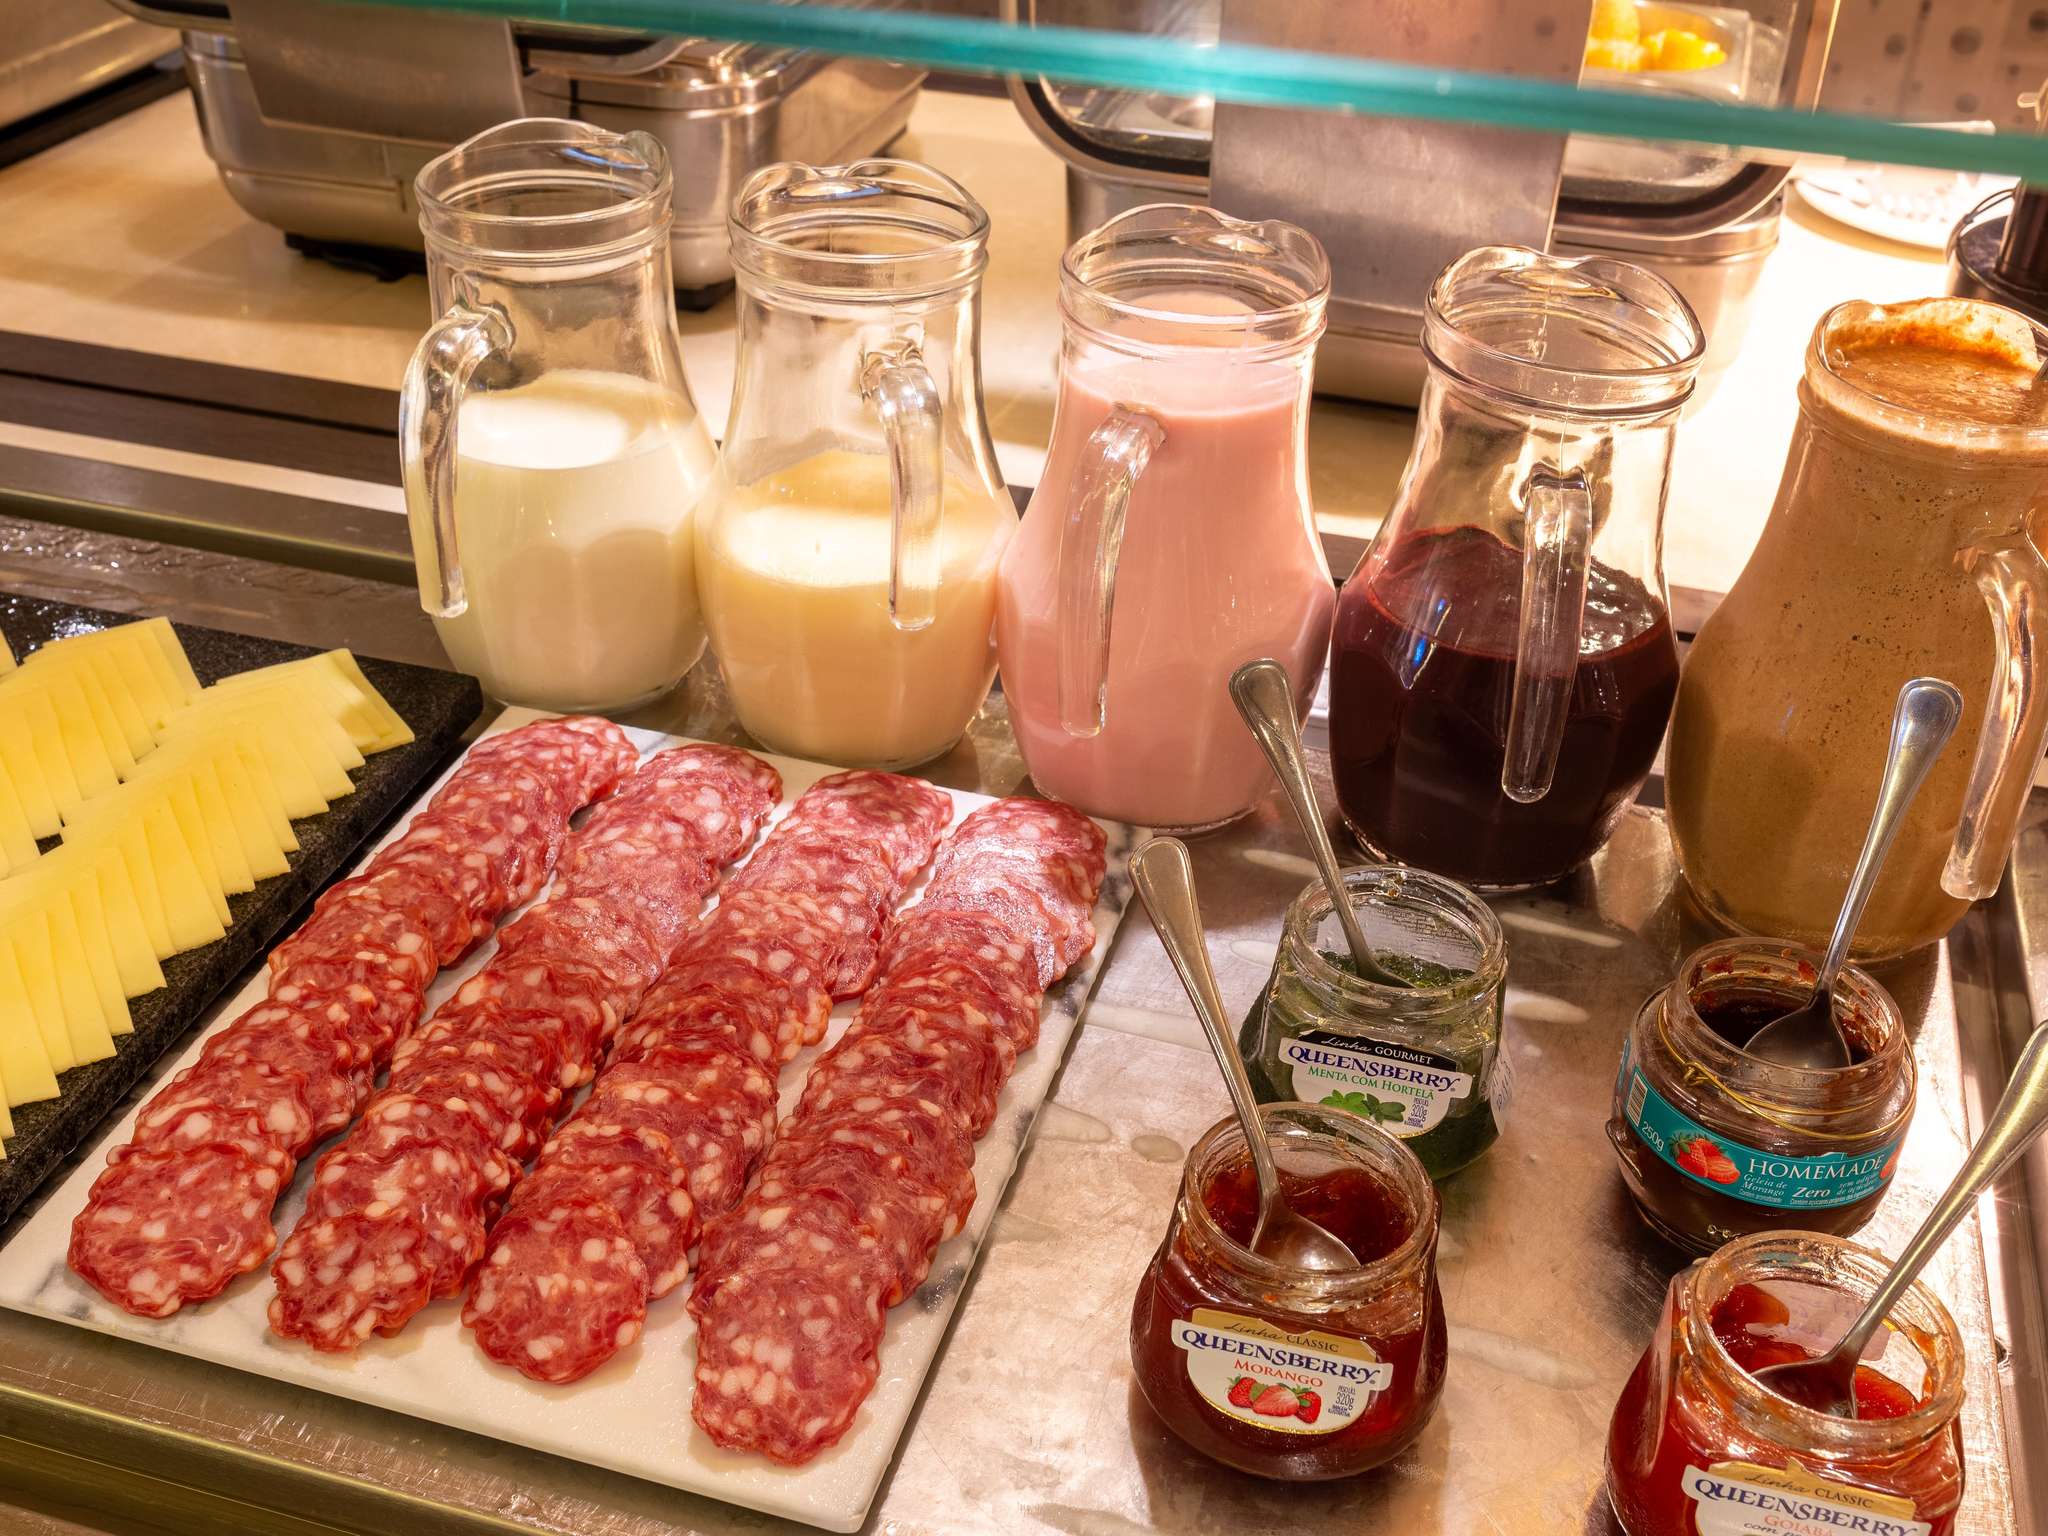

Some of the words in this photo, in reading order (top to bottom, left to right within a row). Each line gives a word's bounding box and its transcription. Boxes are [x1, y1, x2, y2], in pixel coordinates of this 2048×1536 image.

[1321, 1037, 1371, 1052] Linha
[1375, 1047, 1433, 1065] GOURMET
[1288, 1045, 1461, 1091] QUEENSBERRY
[1642, 1121, 1664, 1151] 250g
[1749, 1154, 1883, 1180] HOMEMADE
[1742, 1181, 1785, 1196] Morango
[1792, 1187, 1831, 1198] Zero
[1224, 1323, 1282, 1341] Linha
[1286, 1335, 1339, 1353] CLASSIC
[1182, 1329, 1380, 1384] QUEENSBERRY
[1234, 1359, 1323, 1388] MORANGO
[1336, 1392, 1354, 1410] 320g
[1744, 1473, 1811, 1493] Linha
[1815, 1487, 1874, 1509] CLASSIC
[1744, 1522, 1777, 1535] com
